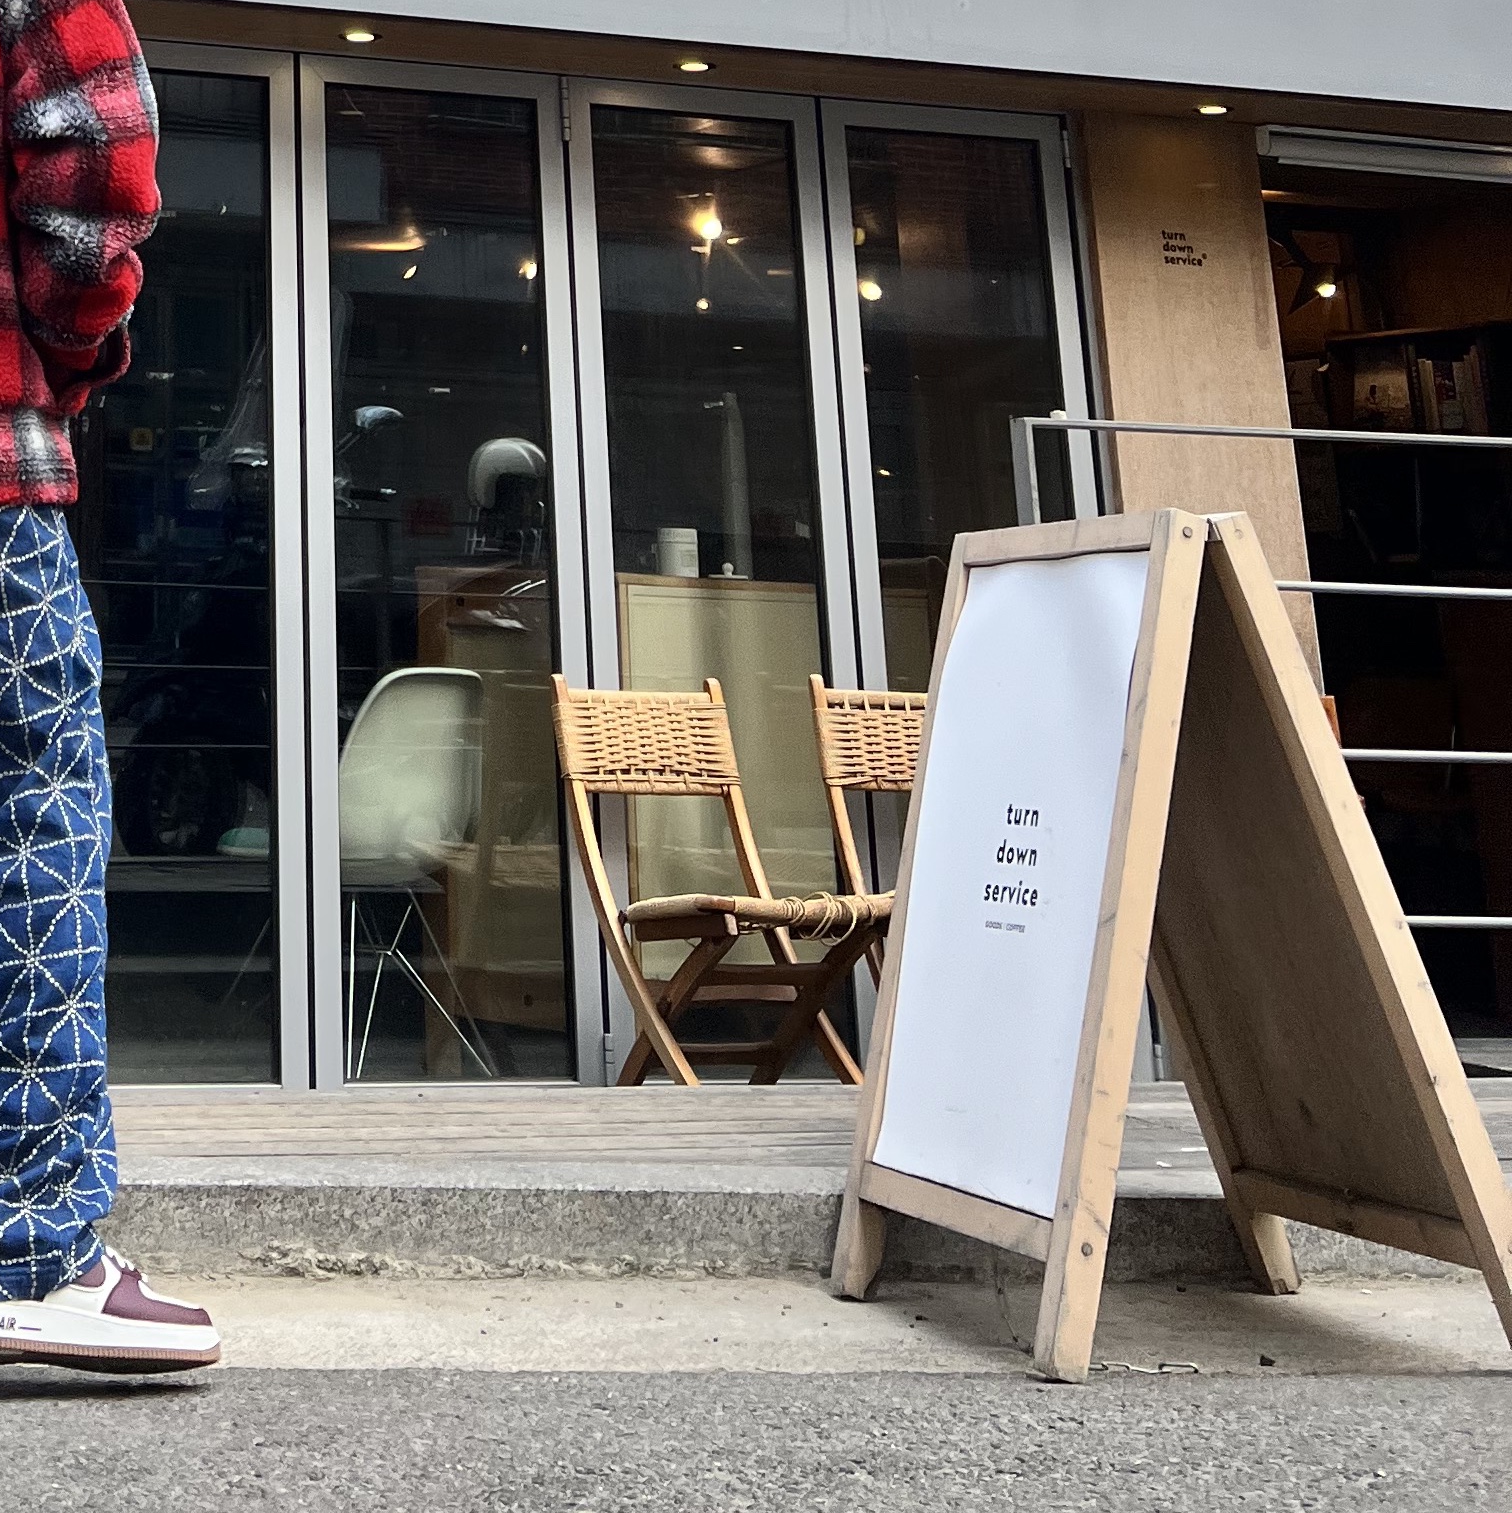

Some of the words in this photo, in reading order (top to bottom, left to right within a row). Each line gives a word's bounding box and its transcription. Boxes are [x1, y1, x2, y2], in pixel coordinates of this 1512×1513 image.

[1161, 230, 1186, 241] turn
[1162, 241, 1194, 254] down
[1164, 254, 1203, 267] service
[1006, 803, 1039, 827] turn
[996, 839, 1038, 867] down
[983, 880, 1039, 907] service
